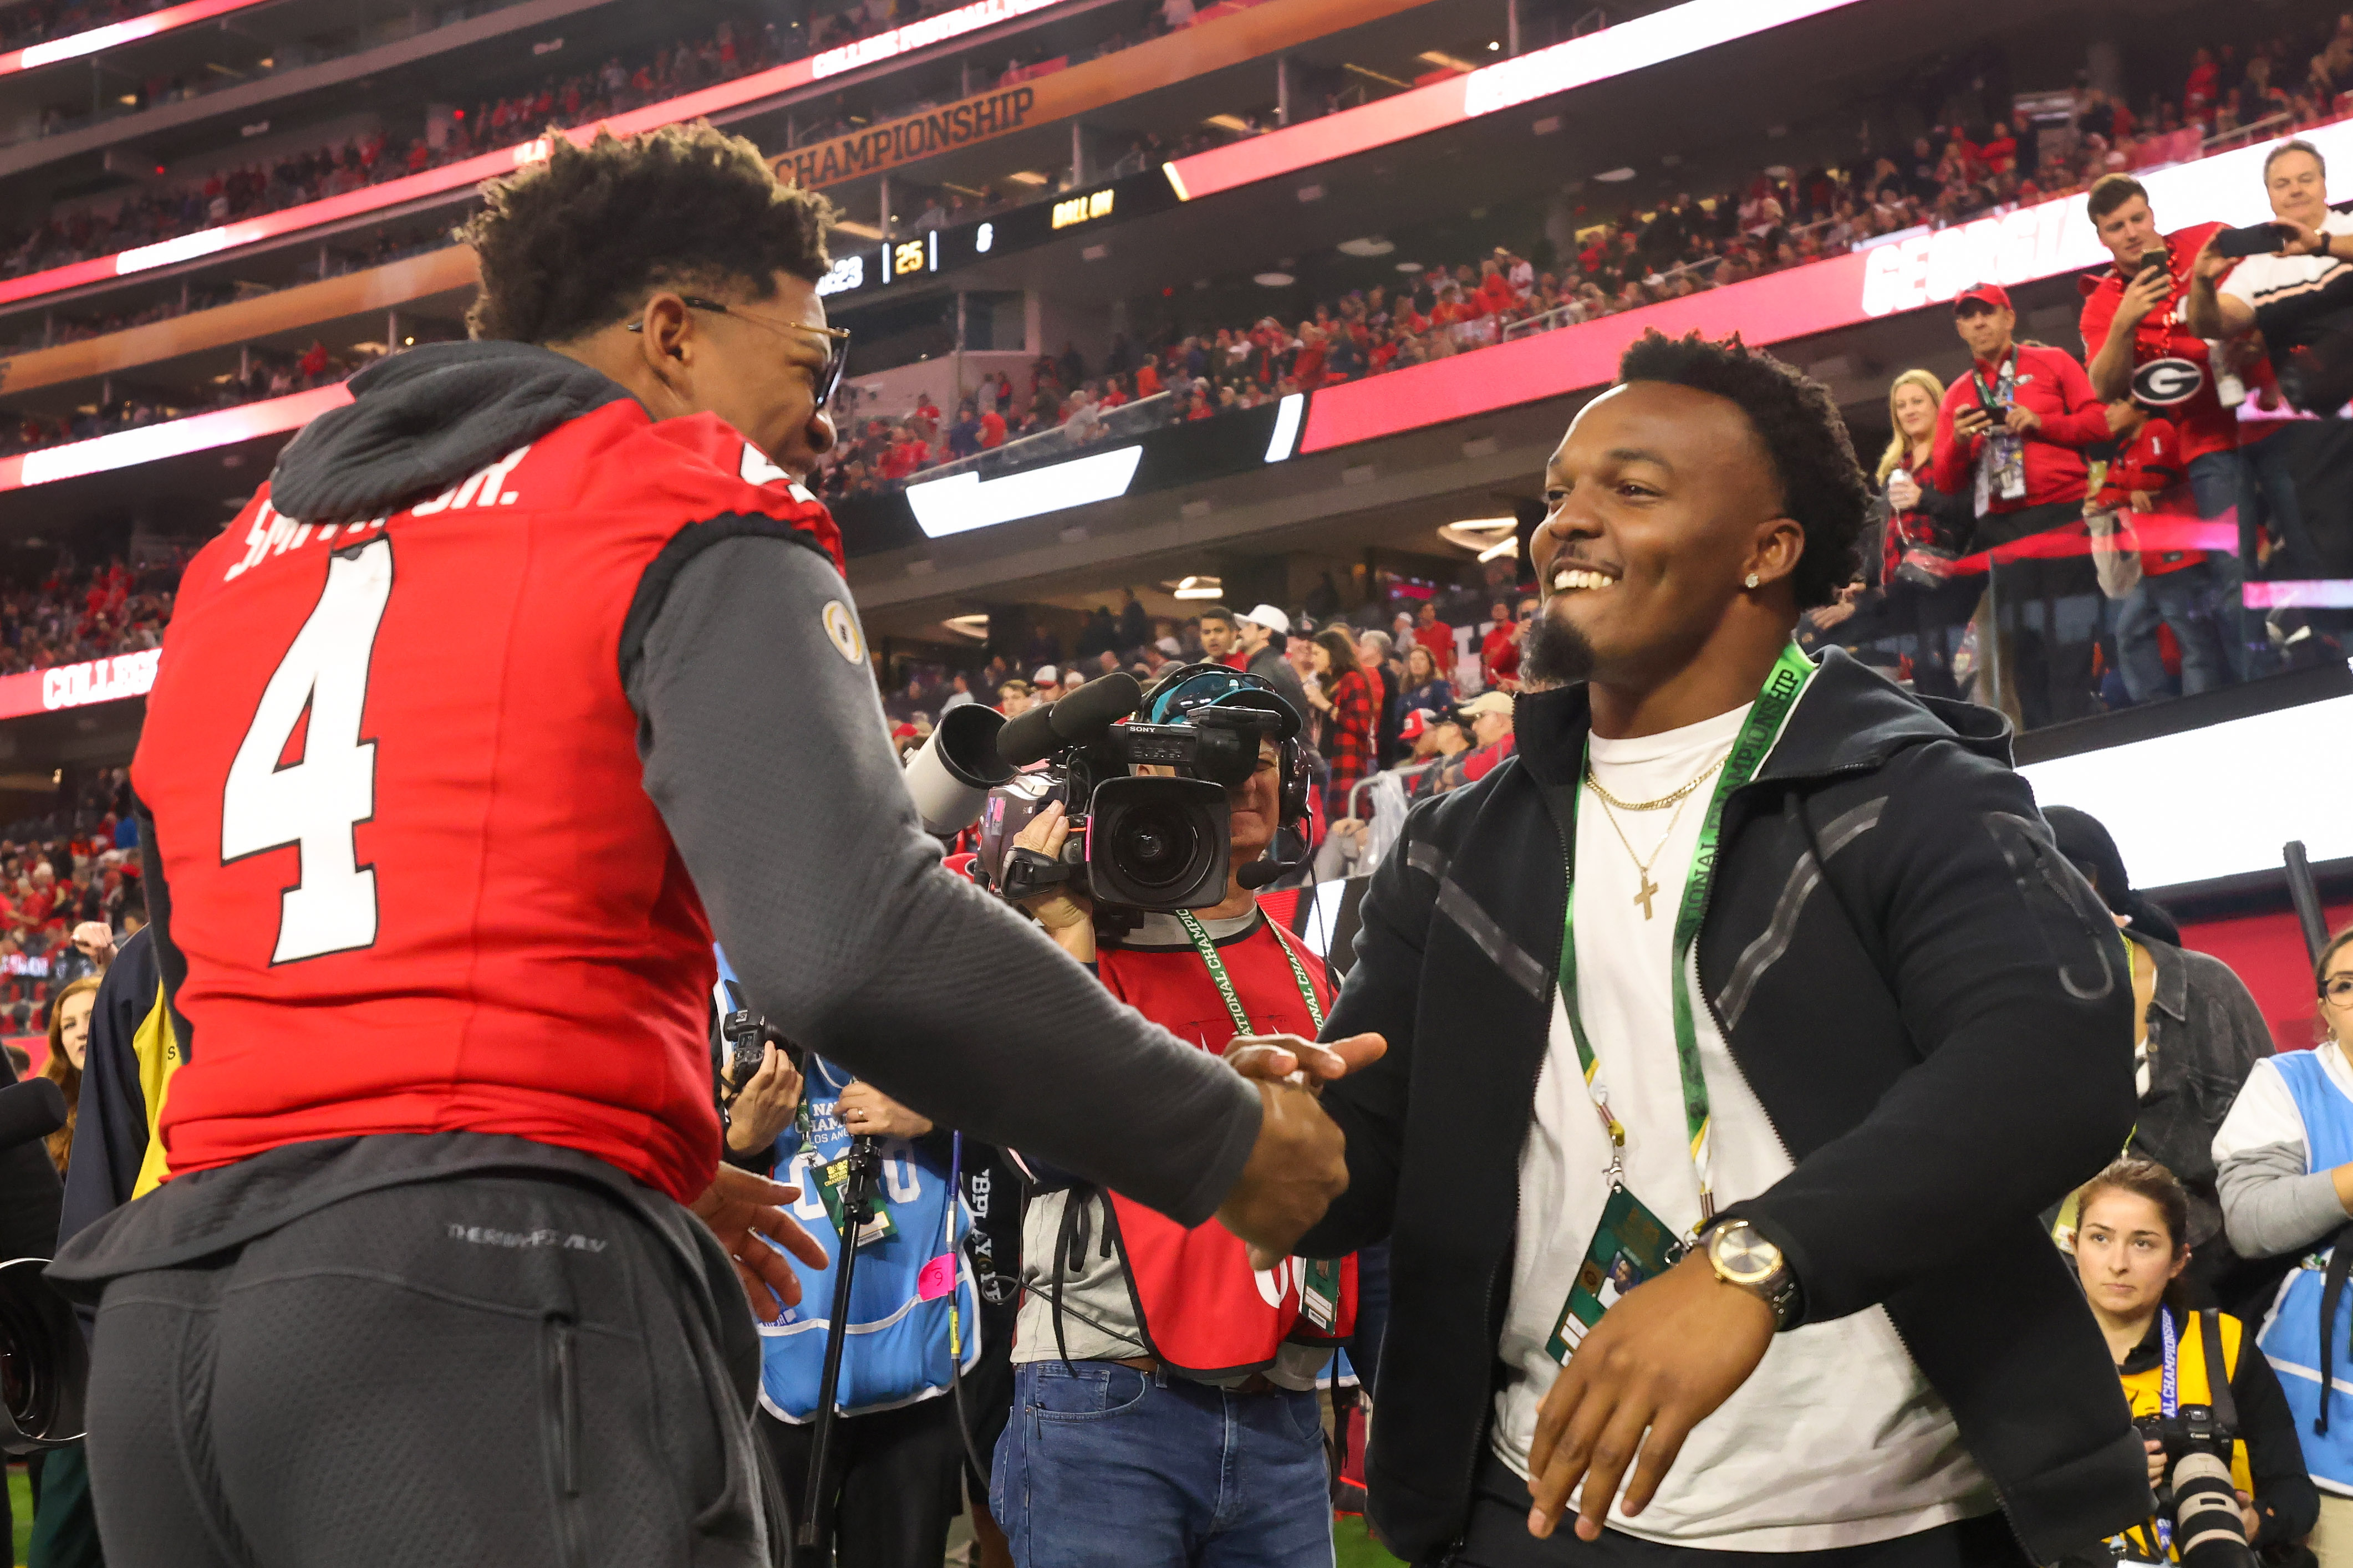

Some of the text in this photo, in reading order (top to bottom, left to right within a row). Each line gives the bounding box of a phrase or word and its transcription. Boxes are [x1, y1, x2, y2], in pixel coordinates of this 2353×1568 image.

[776, 87, 1034, 190] CHAMPIONSHIP
[895, 240, 924, 275] 25
[222, 531, 394, 967] 4
[809, 1133, 829, 1145] LOS
